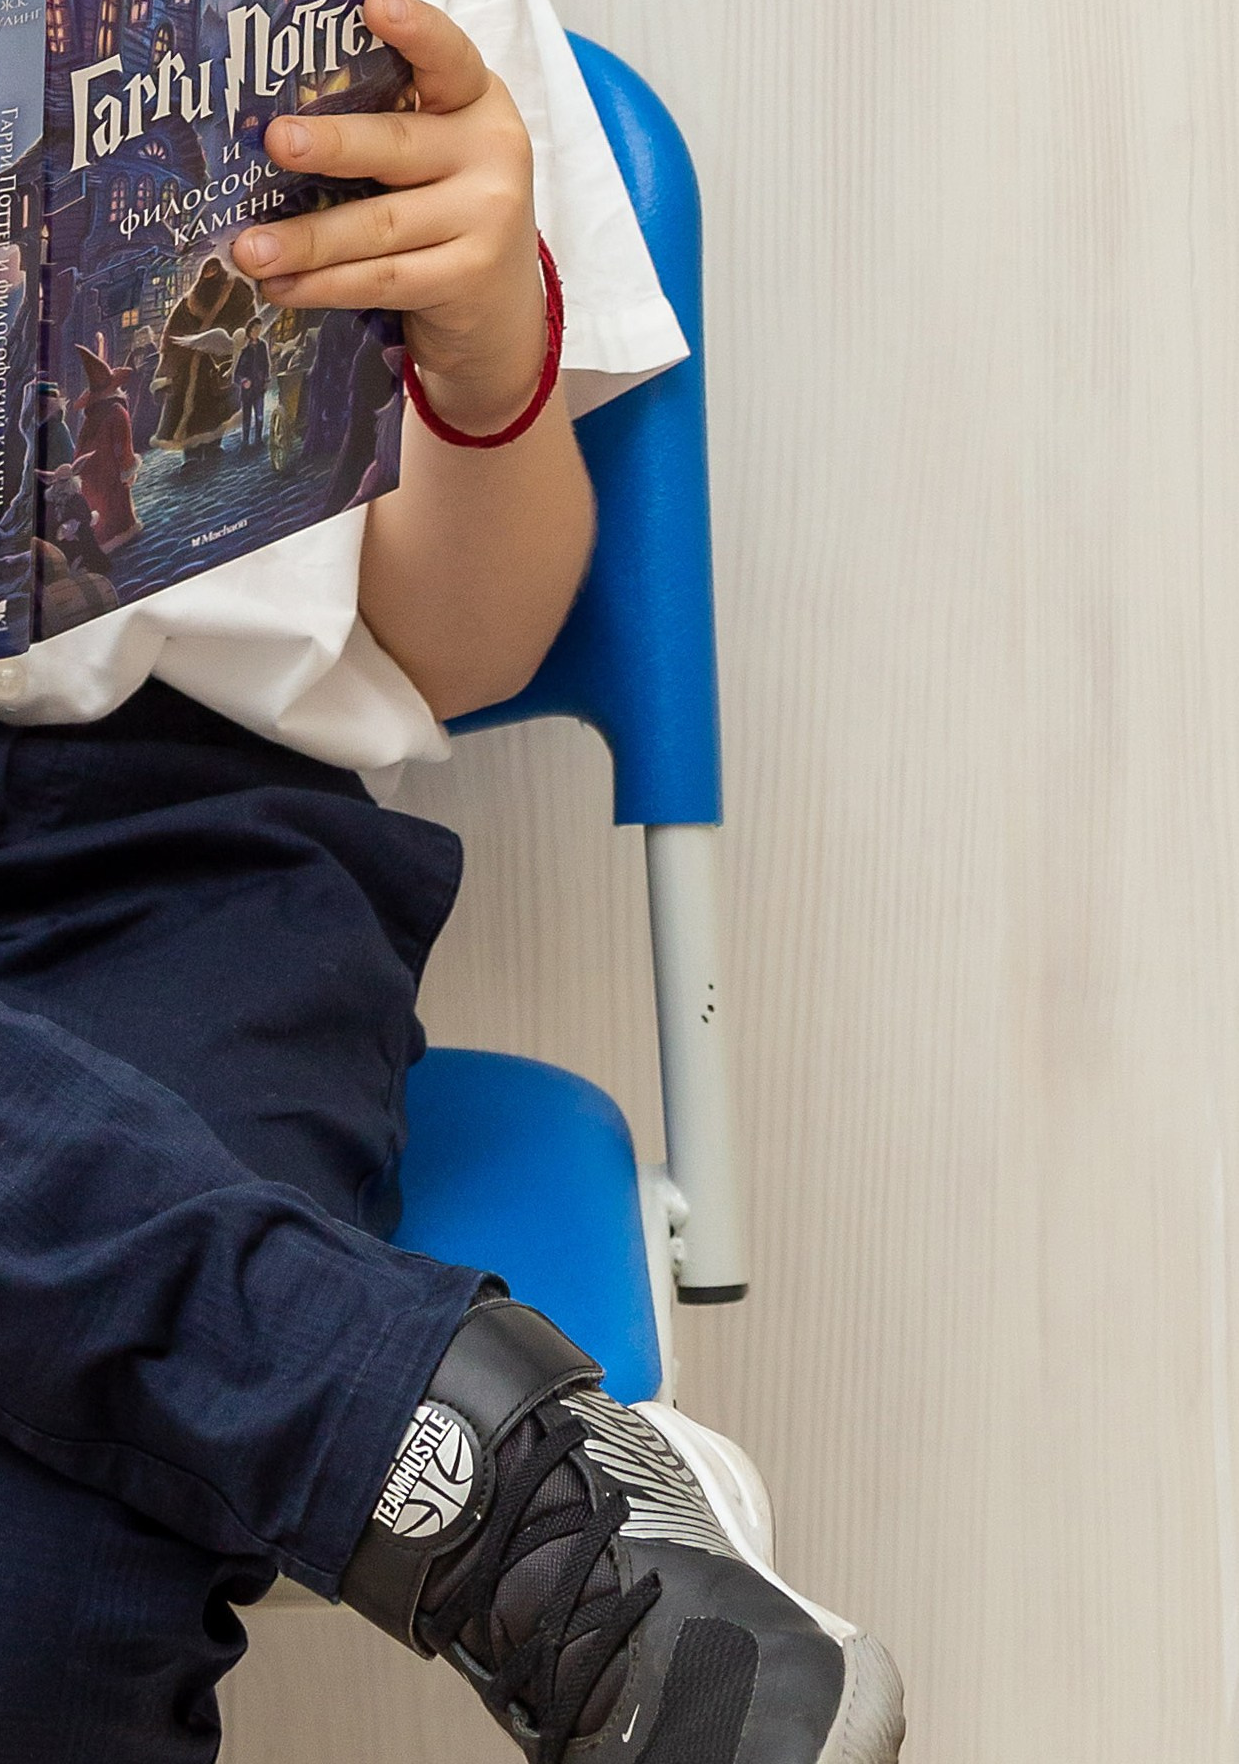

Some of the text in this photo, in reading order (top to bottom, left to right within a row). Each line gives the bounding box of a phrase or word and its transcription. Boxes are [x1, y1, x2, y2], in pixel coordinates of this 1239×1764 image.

[222, 141, 242, 165] И
[118, 159, 286, 241] ФИЛОСОФС
[173, 188, 286, 247] КАМЕНЬ
[371, 1409, 454, 1529] TEAMHUSTLE
